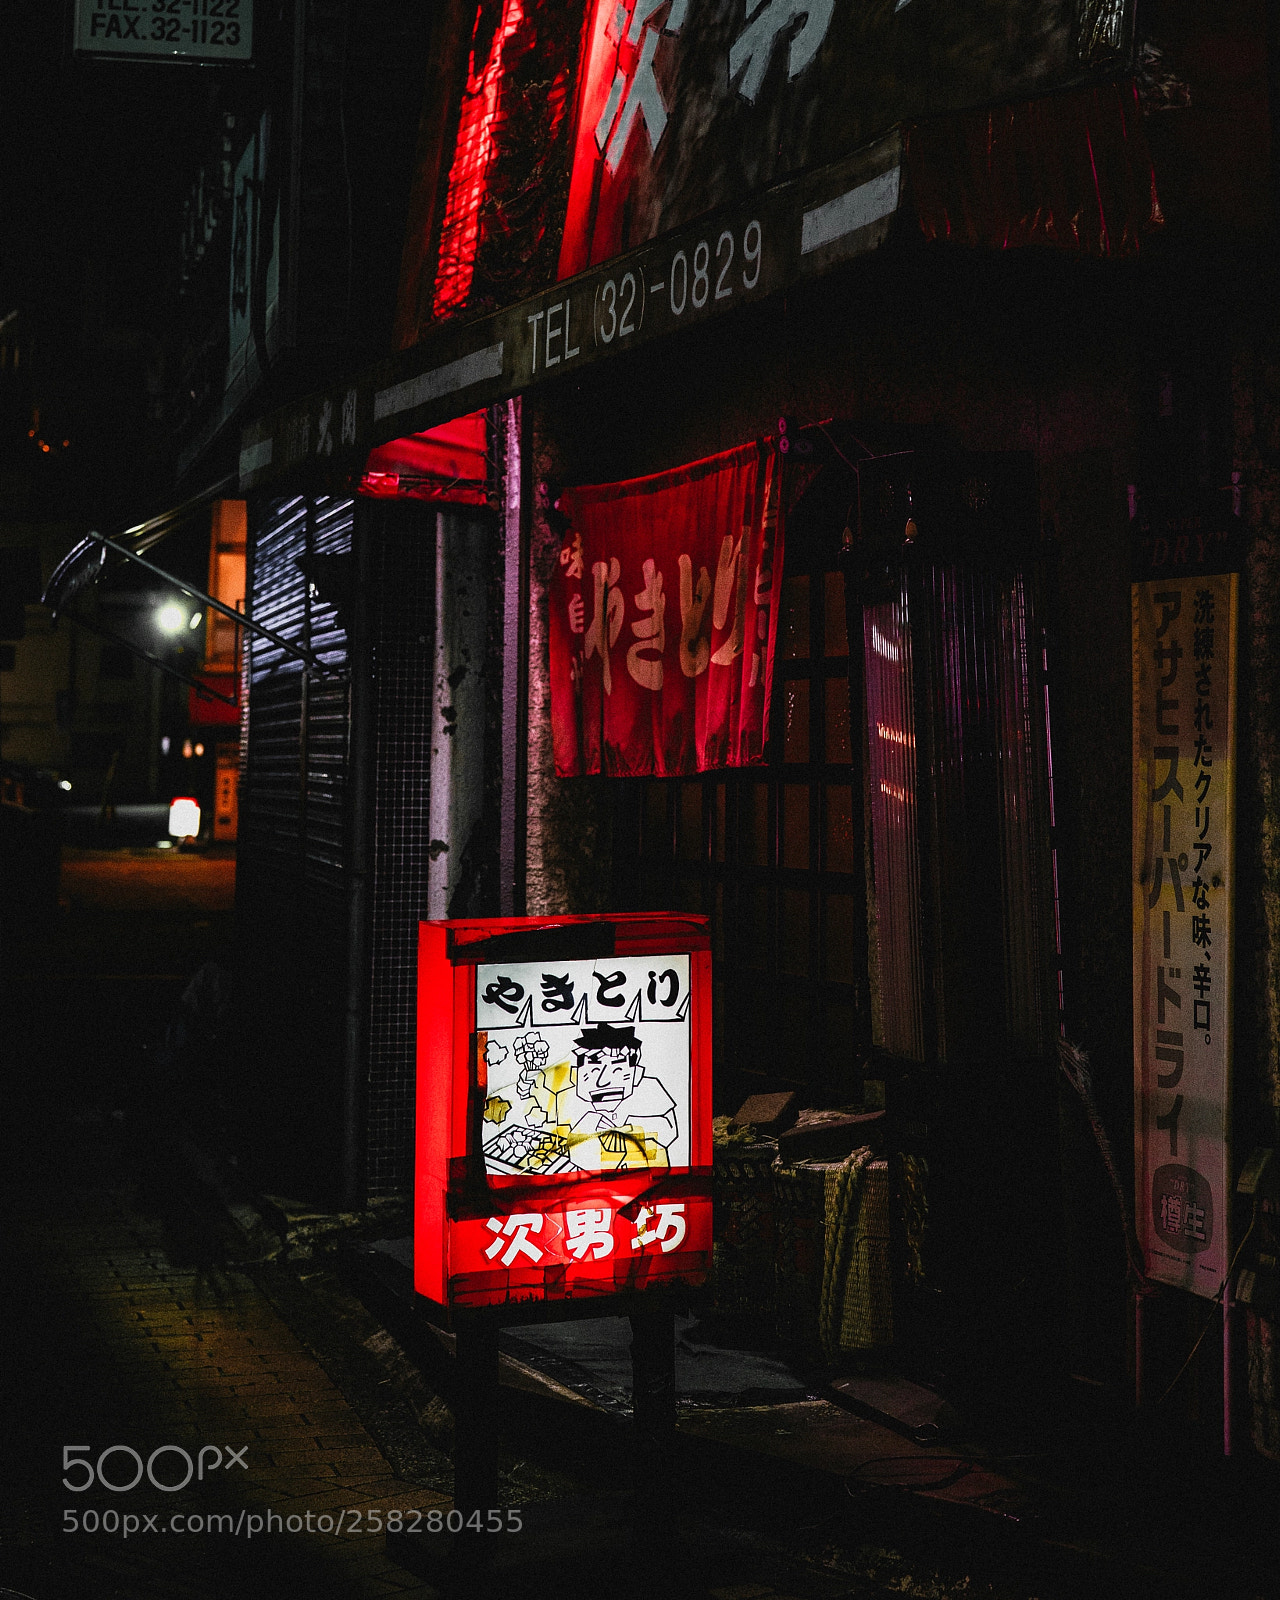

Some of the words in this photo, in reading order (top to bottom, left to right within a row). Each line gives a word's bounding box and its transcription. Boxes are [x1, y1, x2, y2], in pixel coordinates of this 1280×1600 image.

[91, 13, 241, 46] FAX.32-1123
[528, 298, 580, 373] TEL
[594, 219, 762, 347] (32)-0829
[584, 525, 752, 696] やきとり
[1192, 589, 1215, 1044] 洗練されたクリアな味、辛口。
[1150, 591, 1188, 1156] アサヒスーパードライ
[481, 969, 681, 1014] やきとり
[484, 1203, 687, 1267] 次男坊
[1160, 1193, 1206, 1242] 樽生
